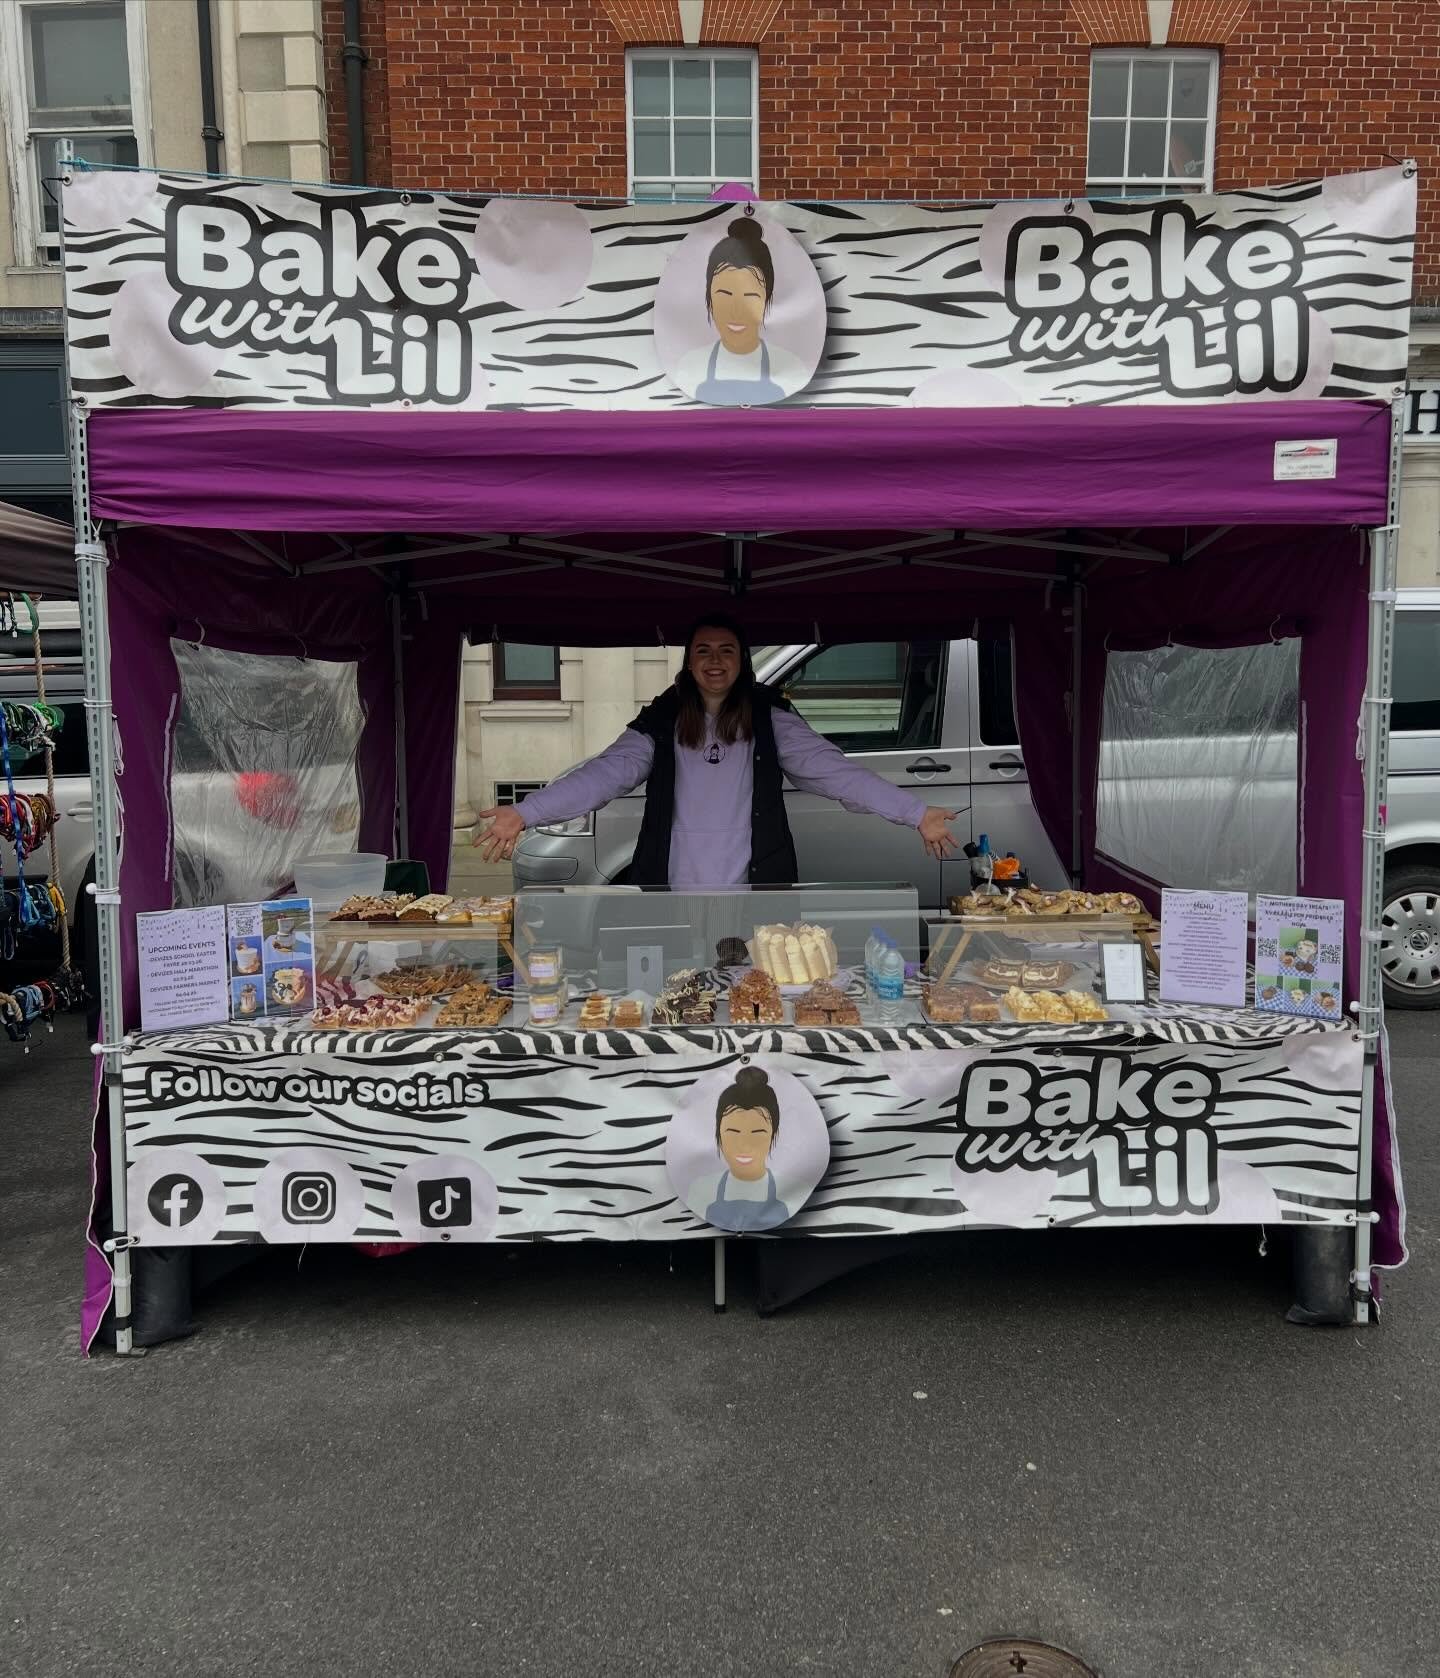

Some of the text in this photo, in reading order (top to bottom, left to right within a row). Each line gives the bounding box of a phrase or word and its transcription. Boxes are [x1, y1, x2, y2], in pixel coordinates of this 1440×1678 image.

[176, 204, 462, 306] Bake
[1014, 212, 1295, 309] Bake
[179, 295, 339, 346] with
[335, 314, 463, 398] Lil
[1018, 302, 1170, 352] with
[1164, 295, 1300, 390] Lil
[148, 941, 215, 954] UPCOMING EVENTS
[150, 1069, 486, 1108] Follow our socials
[964, 1056, 1213, 1128] Bake
[964, 1123, 1101, 1165] with
[1094, 1124, 1211, 1208] Lil
